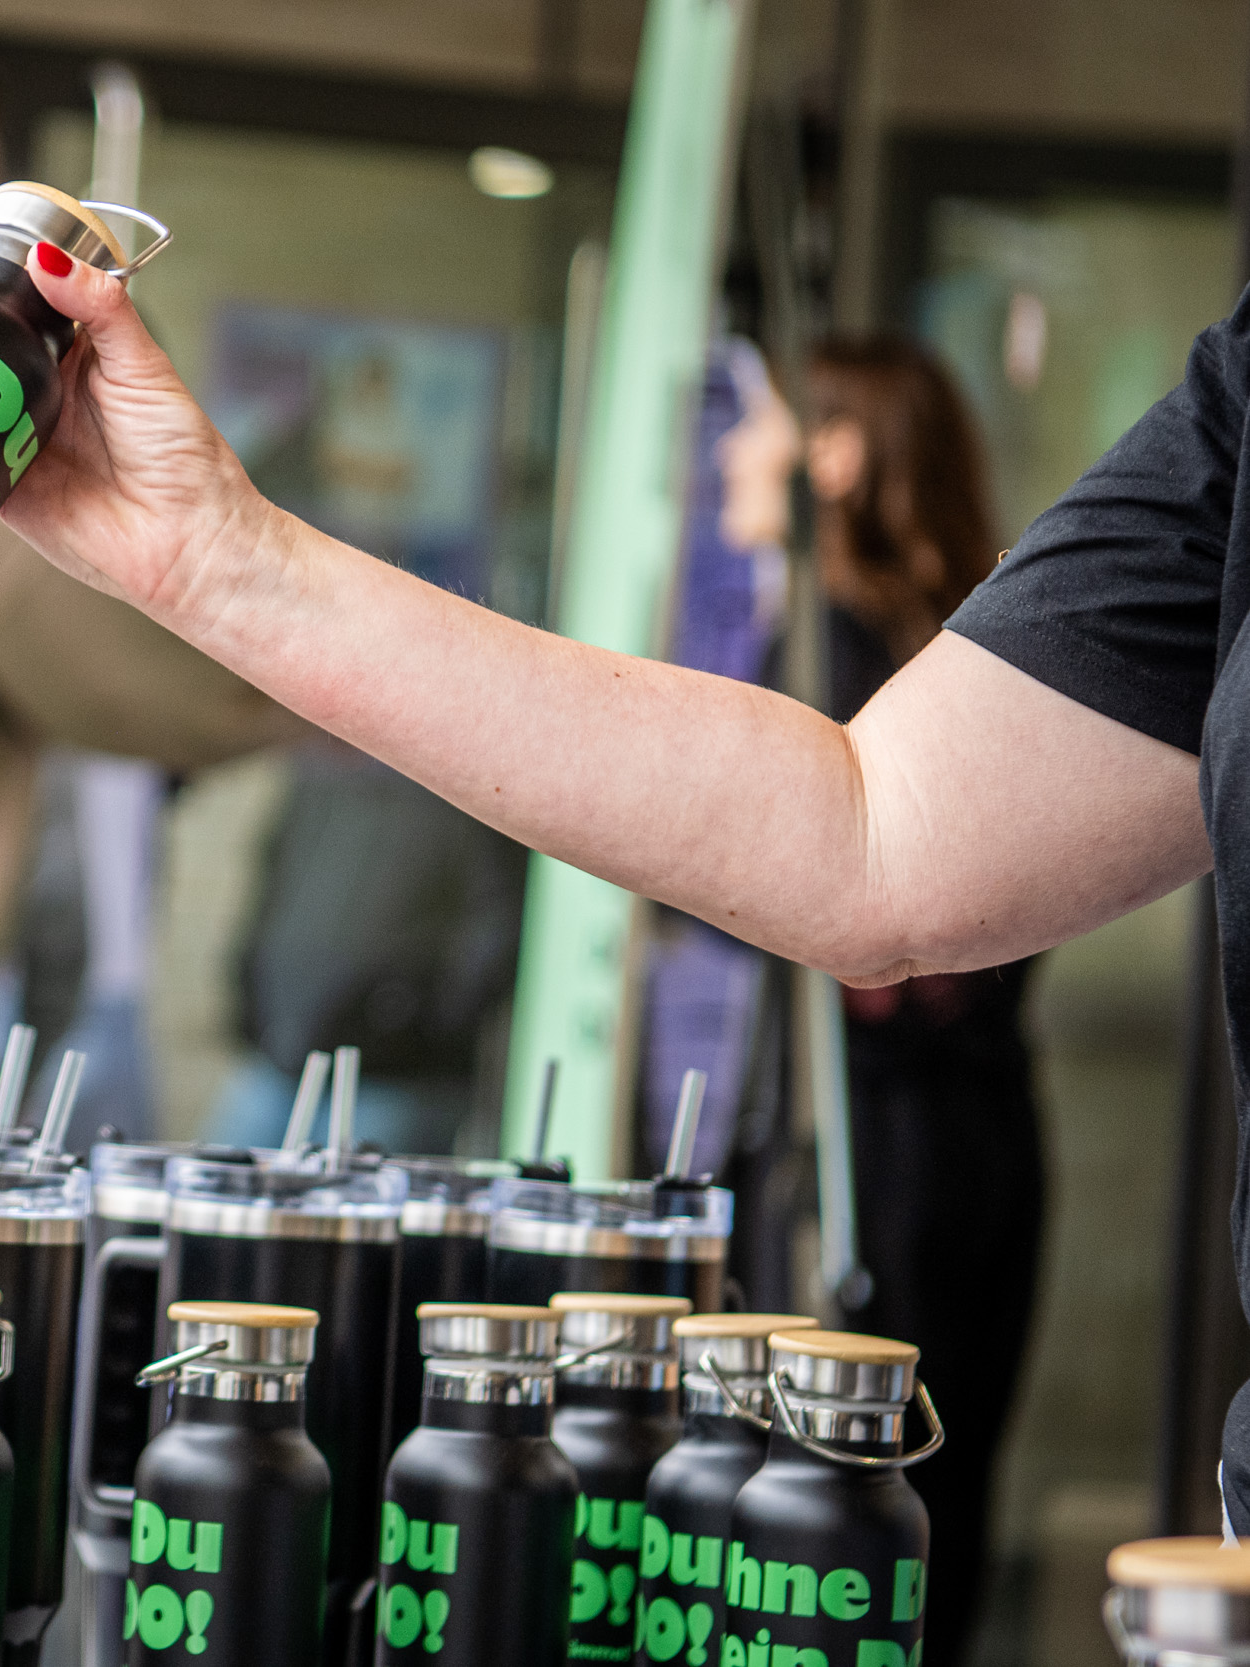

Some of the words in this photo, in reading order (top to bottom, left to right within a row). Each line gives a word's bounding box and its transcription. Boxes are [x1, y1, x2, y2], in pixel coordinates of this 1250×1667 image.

[130, 1498, 224, 1573] Du
[379, 1500, 460, 1575] Du
[639, 1514, 724, 1588] Du
[375, 1581, 450, 1654] O!
[726, 1540, 872, 1621] hne
[635, 1594, 714, 1667] O!
